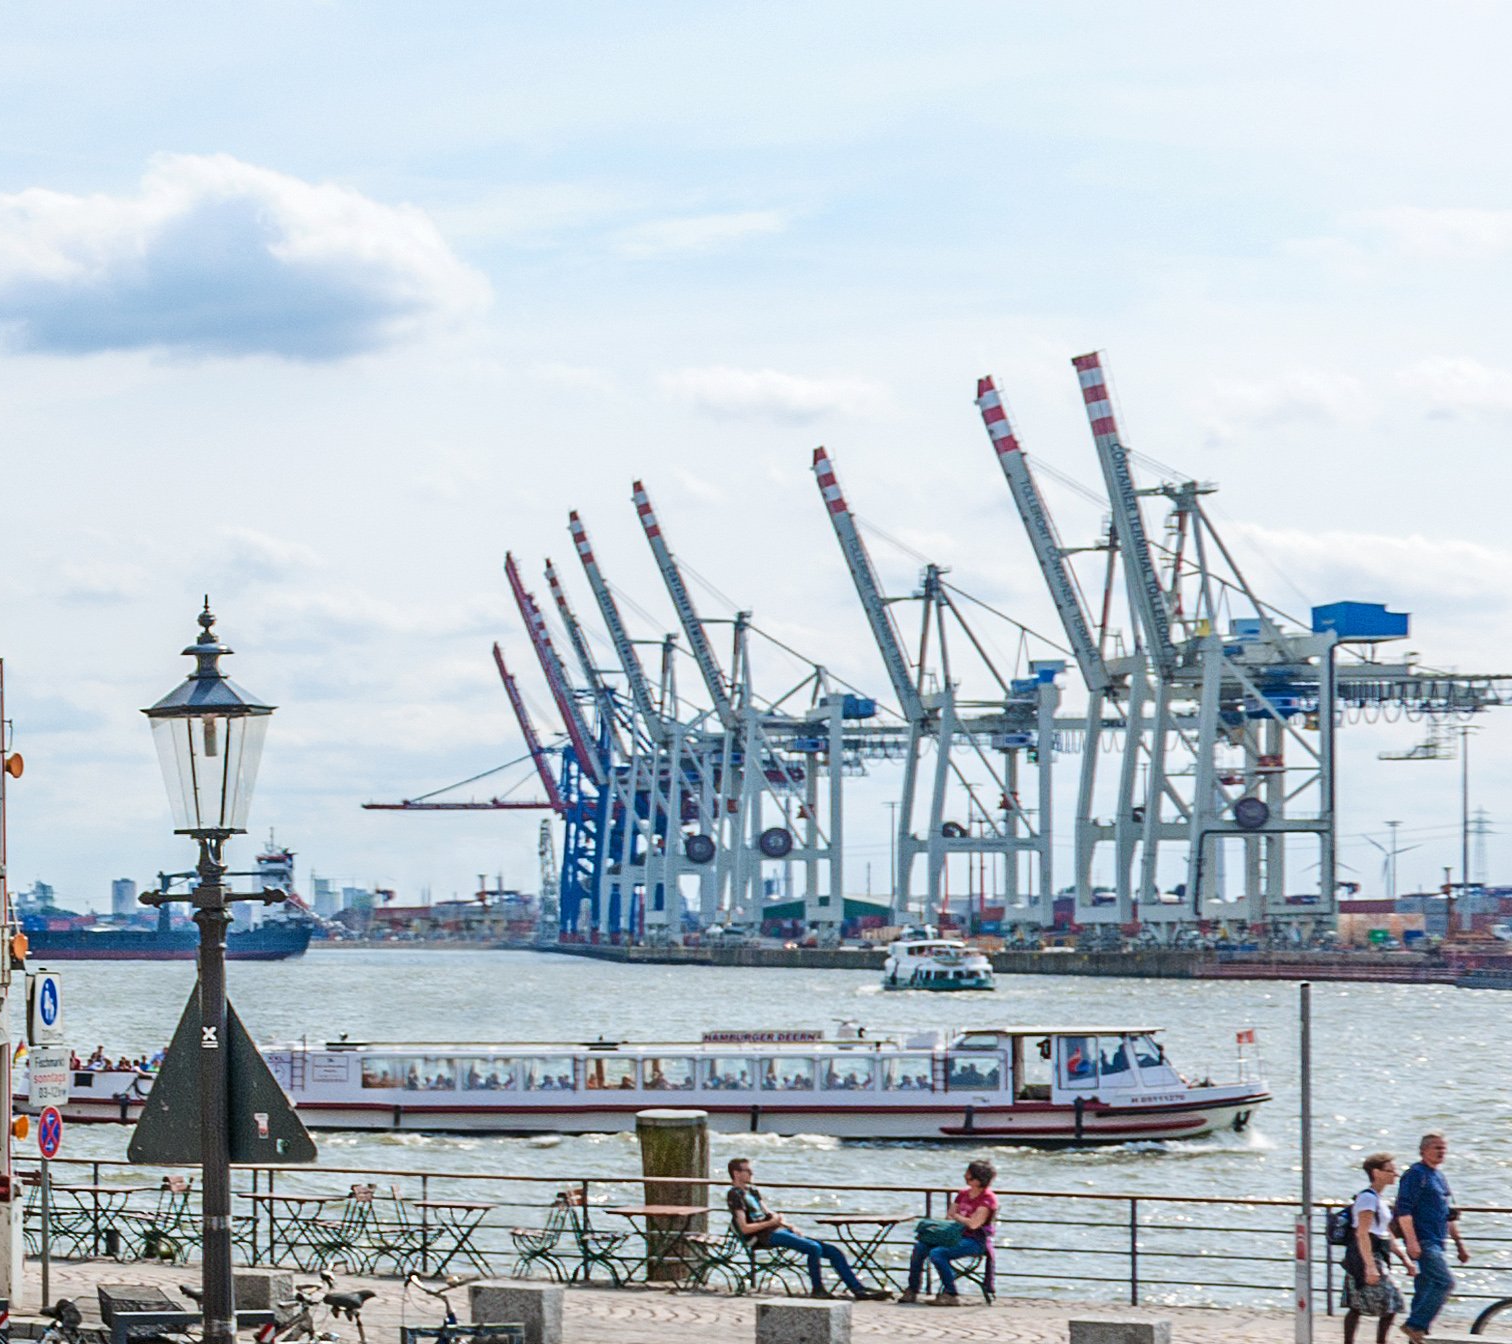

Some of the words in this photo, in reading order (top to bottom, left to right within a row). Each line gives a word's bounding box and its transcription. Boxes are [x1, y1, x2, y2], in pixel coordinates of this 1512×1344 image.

[1108, 442, 1137, 512] CONTAINER
[1127, 515, 1153, 576] TERMINAL
[664, 564, 691, 612] CONTAINER
[684, 613, 708, 654] TERMINAL
[1018, 478, 1052, 542] TOLLERORT
[1044, 544, 1078, 607] CONTAINER
[1070, 612, 1100, 665] TERMINAL
[704, 1032, 774, 1041] HAMBURGER
